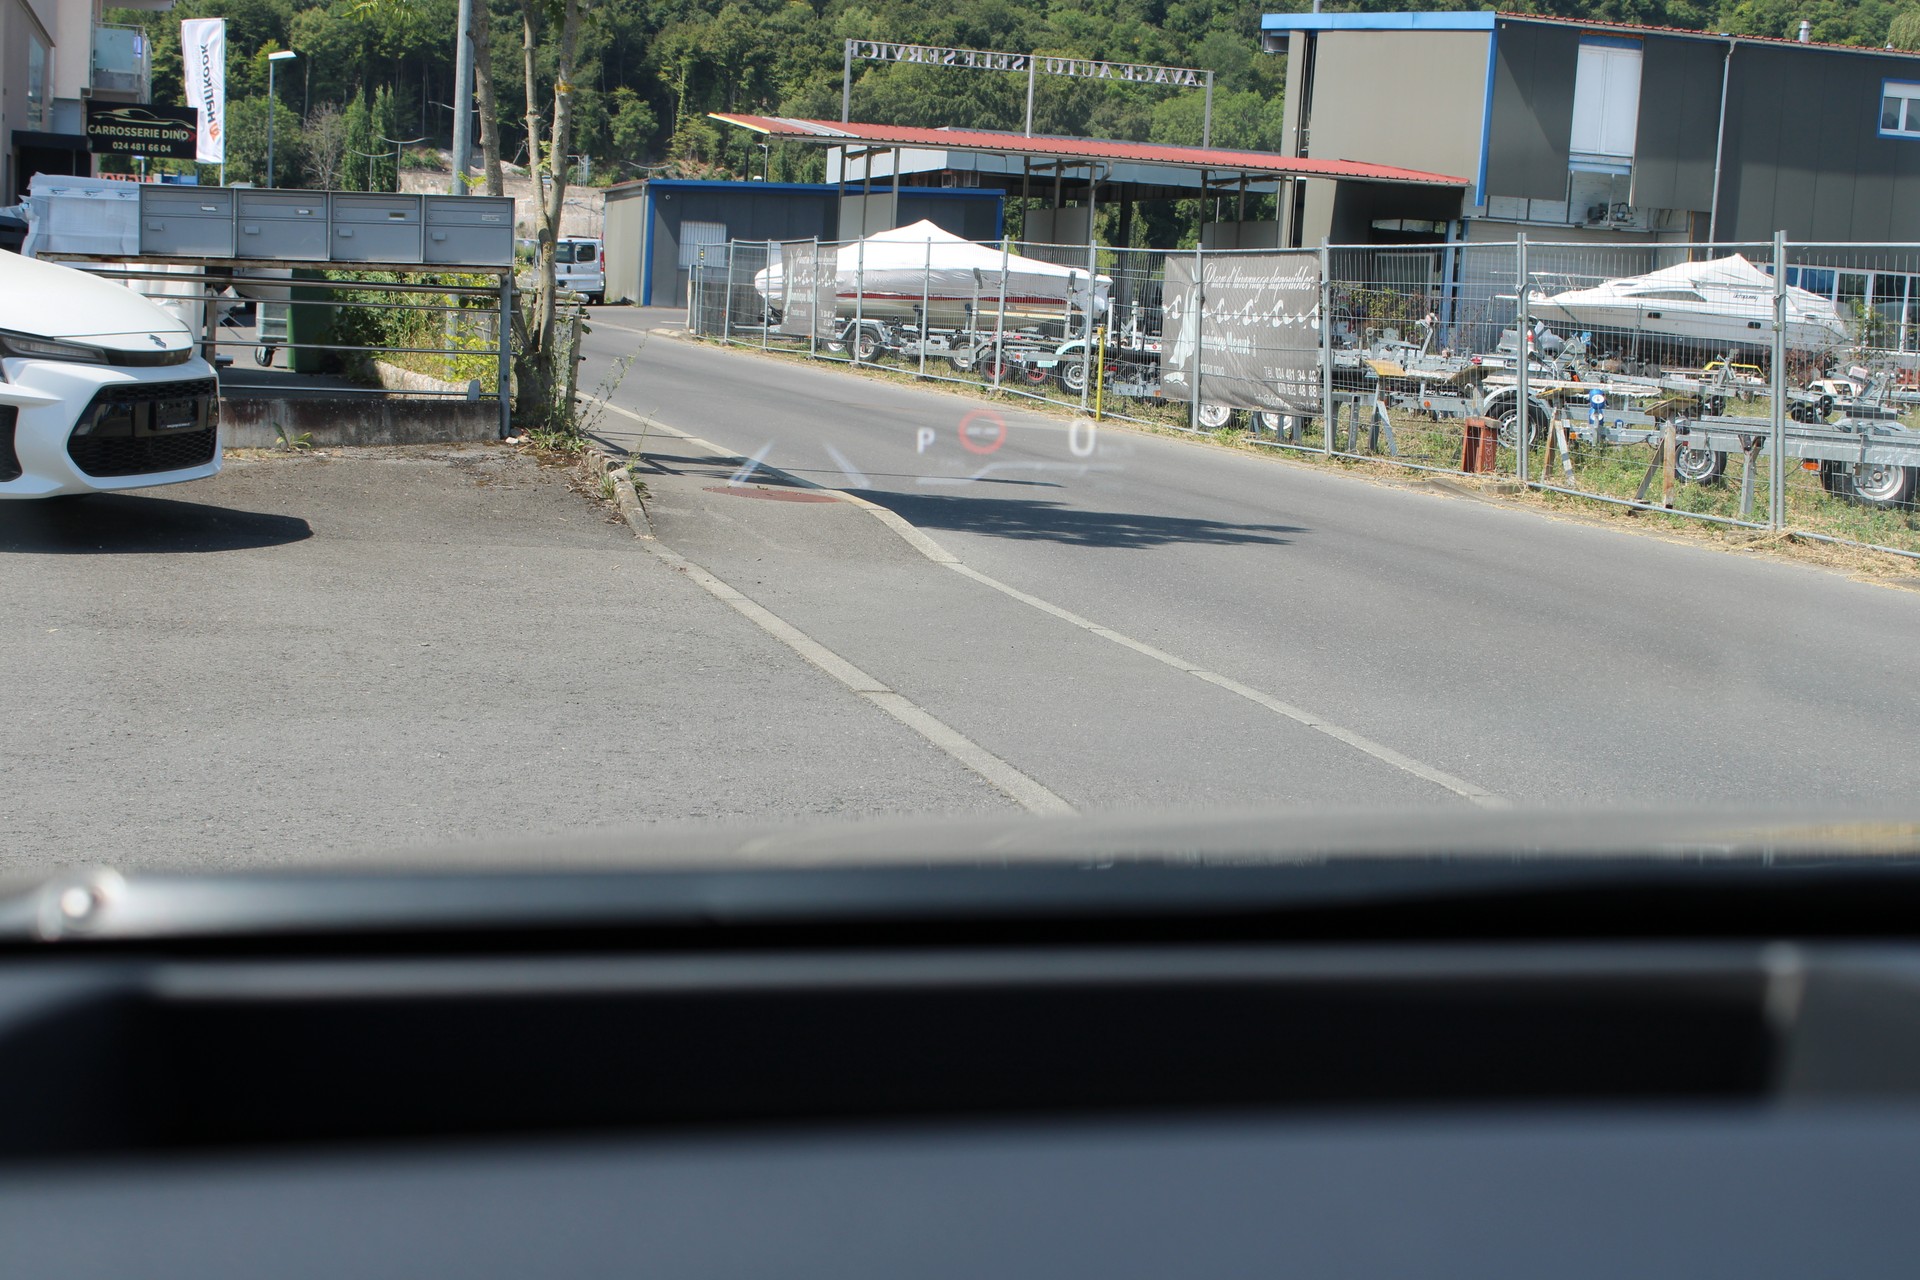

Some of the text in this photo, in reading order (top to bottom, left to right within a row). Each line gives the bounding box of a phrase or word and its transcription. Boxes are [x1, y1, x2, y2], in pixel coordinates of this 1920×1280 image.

[87, 124, 190, 141] CARROSSERIE DINO
[112, 141, 172, 153] 024 481 66 04
[916, 426, 936, 455] P
[1068, 419, 1097, 457] 0
